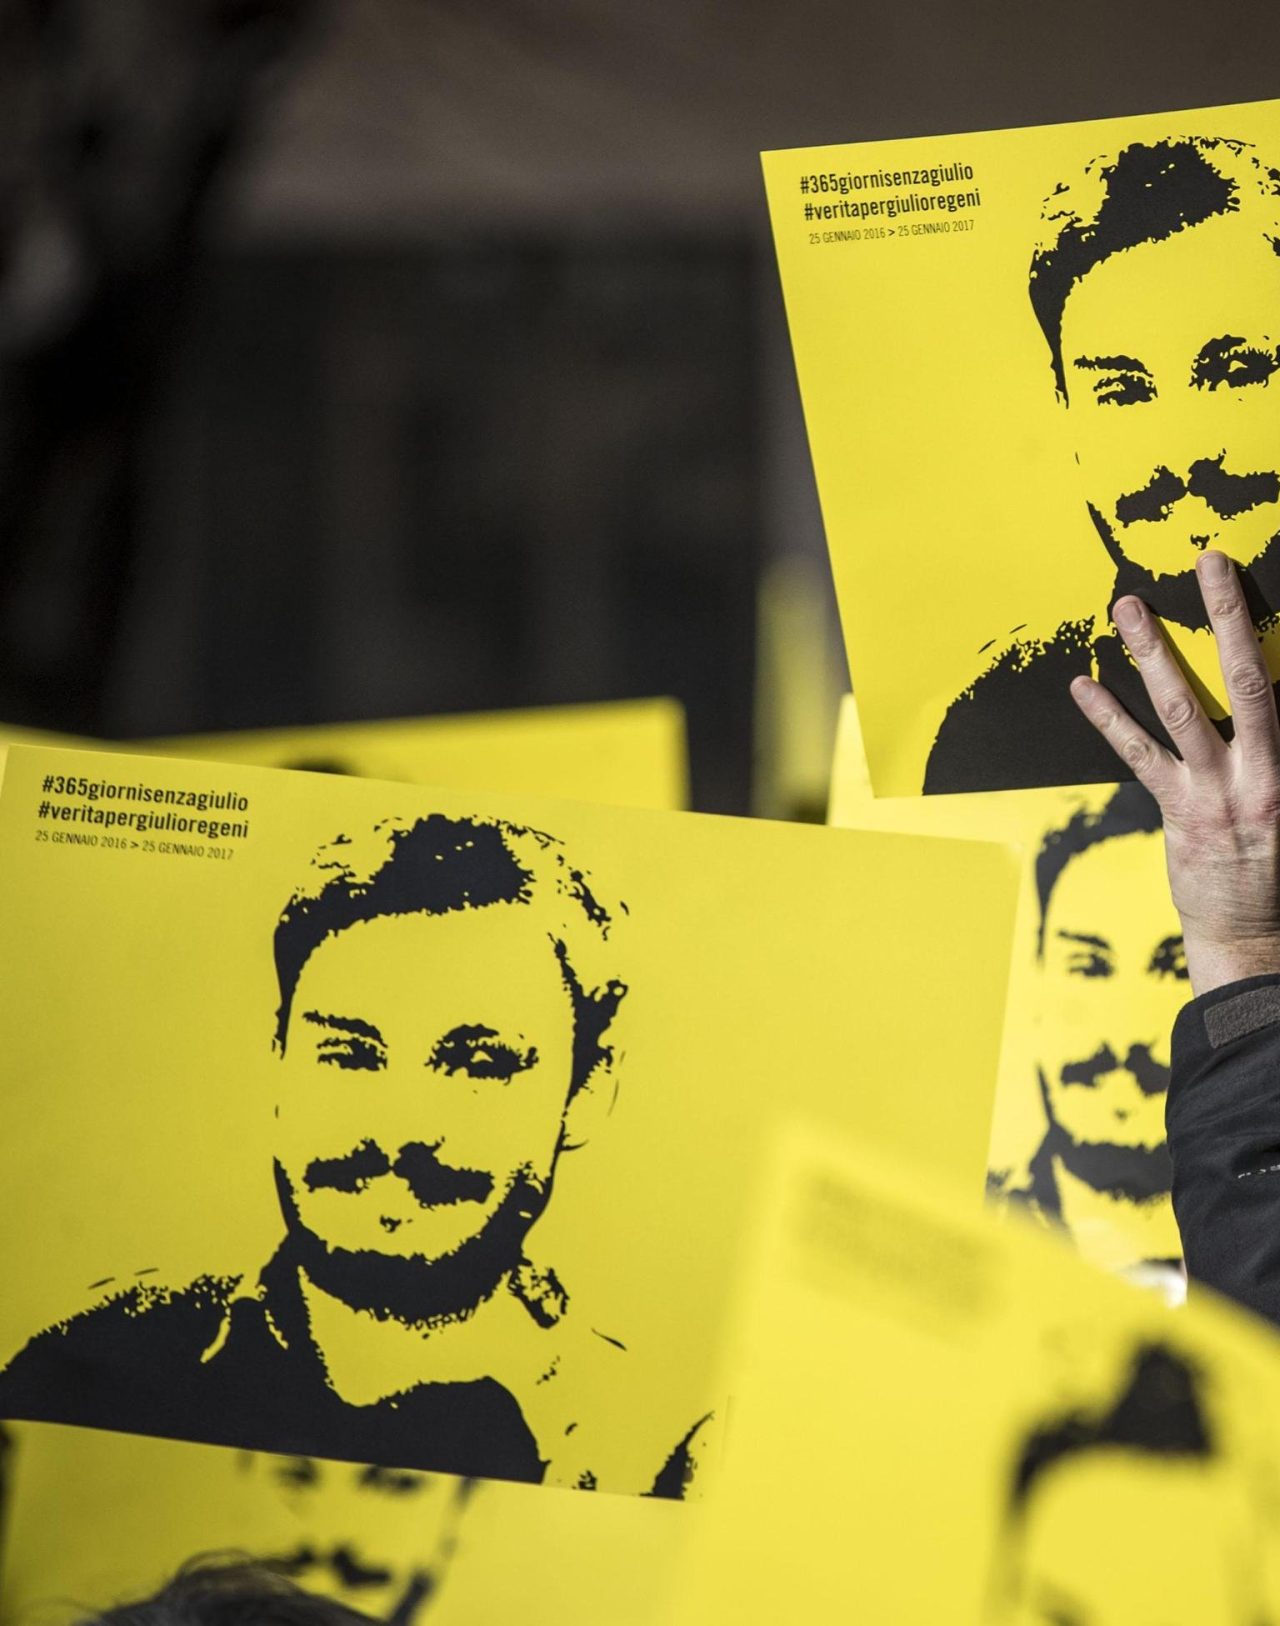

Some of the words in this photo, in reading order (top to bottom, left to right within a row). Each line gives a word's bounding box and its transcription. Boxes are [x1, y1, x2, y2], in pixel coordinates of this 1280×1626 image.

[800, 162, 974, 195] #365giornisenzagiulio
[804, 188, 982, 221] #veritapergiulioregeni
[808, 232, 821, 245] 25
[822, 228, 861, 244] GENNAIO
[863, 226, 886, 241] 2016
[898, 225, 910, 238] 25
[911, 221, 951, 236] GENNAIO
[952, 219, 975, 232] 2017
[42, 775, 249, 812] #365giornisenzagiulio
[38, 801, 249, 839] #veritapergiulioregeni
[35, 830, 49, 842] 25
[51, 832, 98, 847] GENNAIO
[100, 836, 128, 850] 2016
[142, 840, 156, 853] 25
[158, 842, 205, 858] GENNAIO
[207, 845, 234, 861] 2017
